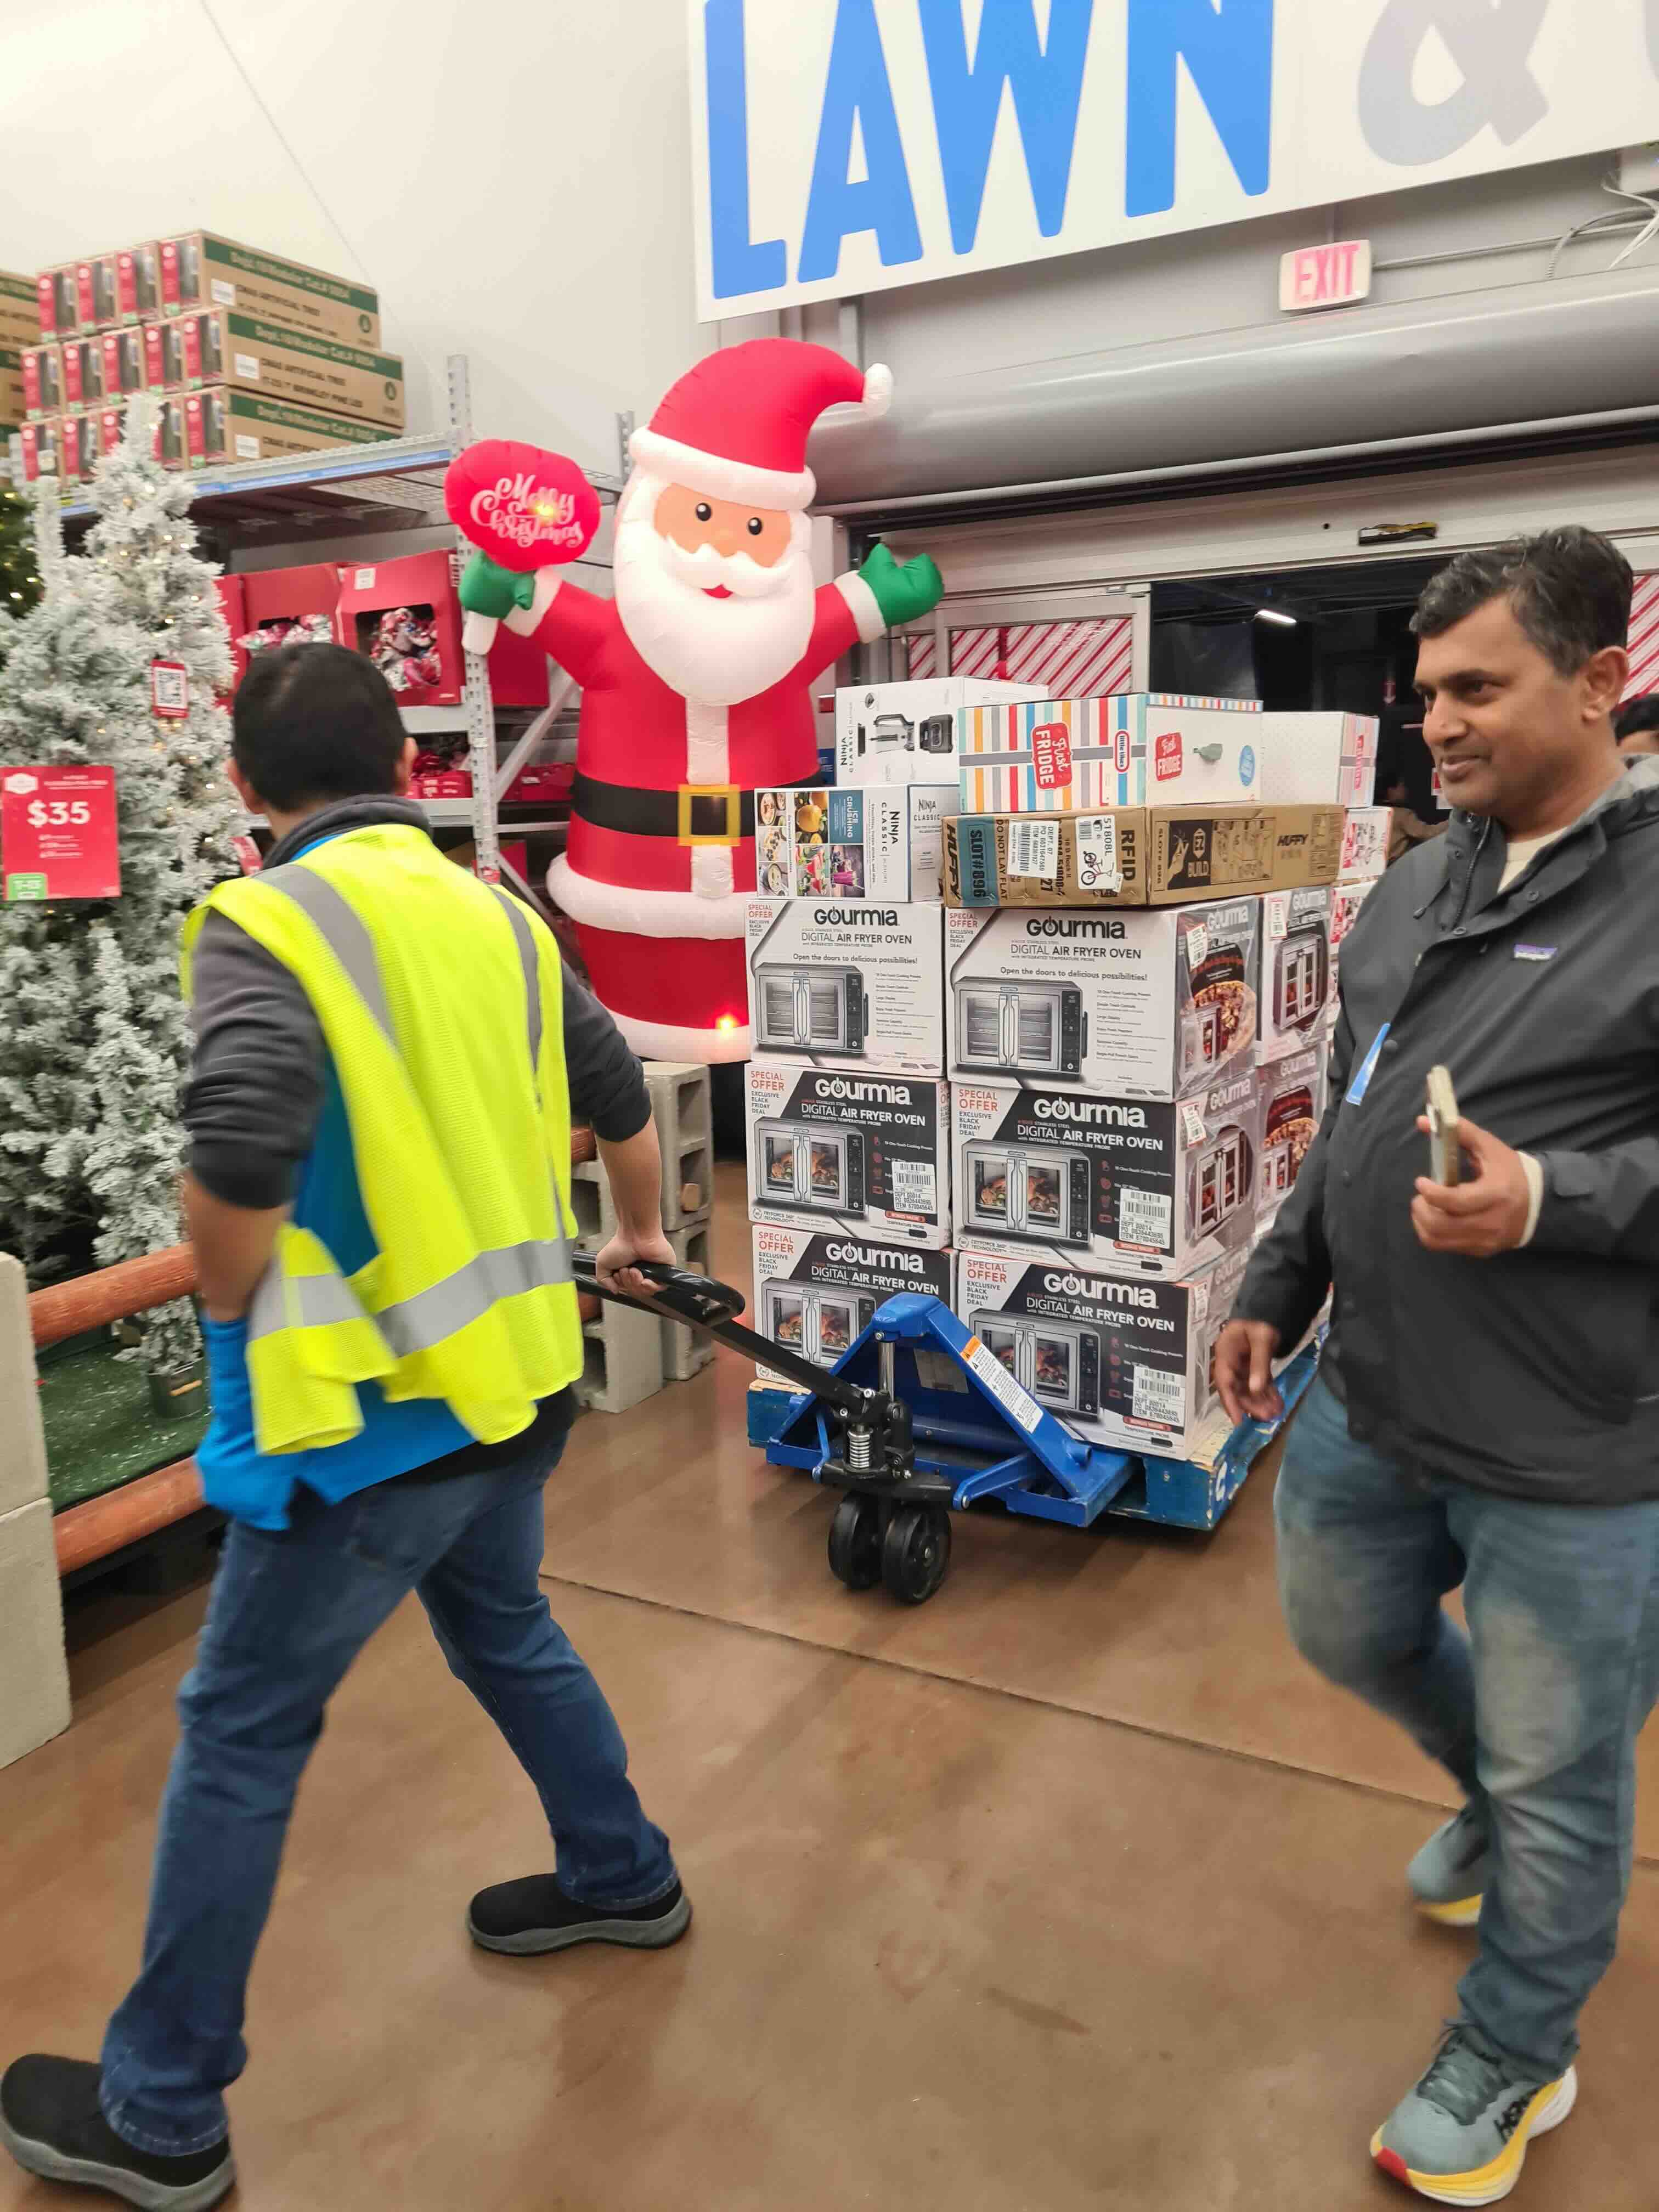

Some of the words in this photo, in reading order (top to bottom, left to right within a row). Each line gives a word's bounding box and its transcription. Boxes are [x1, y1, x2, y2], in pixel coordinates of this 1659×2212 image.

[704, 0, 1273, 299] LAWN
[1295, 245, 1361, 302] EXIT
[1035, 729, 1055, 785] FRIDGE
[1052, 737, 1070, 772] First
[27, 799, 91, 828] $35
[918, 799, 936, 812] NINJA
[888, 811, 900, 844] NINJA
[996, 820, 1005, 832] DO
[997, 836, 1006, 855] NOT
[1277, 834, 1308, 847] HUFFY
[947, 824, 962, 900] HUFFY
[1121, 830, 1136, 881] RFID
[999, 878, 1008, 900] FLAT
[814, 906, 898, 926] Gourmia
[950, 919, 978, 928] OFFER
[1026, 916, 1125, 939] Gourmia
[802, 933, 834, 942] DIGITAL
[837, 934, 851, 943] AIR
[854, 934, 882, 944] FRYER
[885, 935, 912, 944] OVEN
[850, 955, 877, 963] delicious
[879, 956, 918, 964] possibilities!
[1011, 944, 1048, 955] DIGITAL
[1052, 946, 1069, 956] AIR
[1073, 947, 1106, 957] FRYER
[1109, 949, 1141, 958] OVEN
[1000, 967, 1019, 975] Open
[1068, 970, 1099, 978] delicious
[1102, 972, 1147, 981] possibilities!
[751, 1070, 784, 1080] SPECIAL
[751, 1080, 785, 1091] OFFER
[815, 1076, 909, 1104] Gourmia
[958, 1088, 997, 1101] SPECIAL
[802, 1103, 838, 1116] DIGITAL
[840, 1108, 857, 1119] AIR
[860, 1110, 892, 1122] FRYER
[895, 1114, 926, 1126] OVEN
[959, 1099, 998, 1111] OFFER
[1034, 1097, 1144, 1127] Gourmia
[1018, 1125, 1060, 1139] DIGITAL
[1063, 1129, 1083, 1142] AIR
[1086, 1131, 1124, 1146] FRYER
[1126, 1137, 1164, 1151] OVEN
[759, 1232, 794, 1244] SPECIAL
[759, 1241, 794, 1254] OFFER
[826, 1242, 923, 1273] Gourmia
[967, 1260, 1007, 1273] SPECIAL
[811, 1266, 849, 1280] DIGITAL
[851, 1272, 870, 1284] AIR
[872, 1274, 905, 1289] FRYER
[907, 1282, 939, 1295] OVEN
[967, 1269, 1007, 1283] OFFER
[1043, 1273, 1156, 1308] Gourmia
[1027, 1297, 1070, 1313] DIGITAL
[1073, 1305, 1093, 1318] AIR
[1097, 1308, 1134, 1325] FRYER
[1136, 1316, 1175, 1332] OVEN
